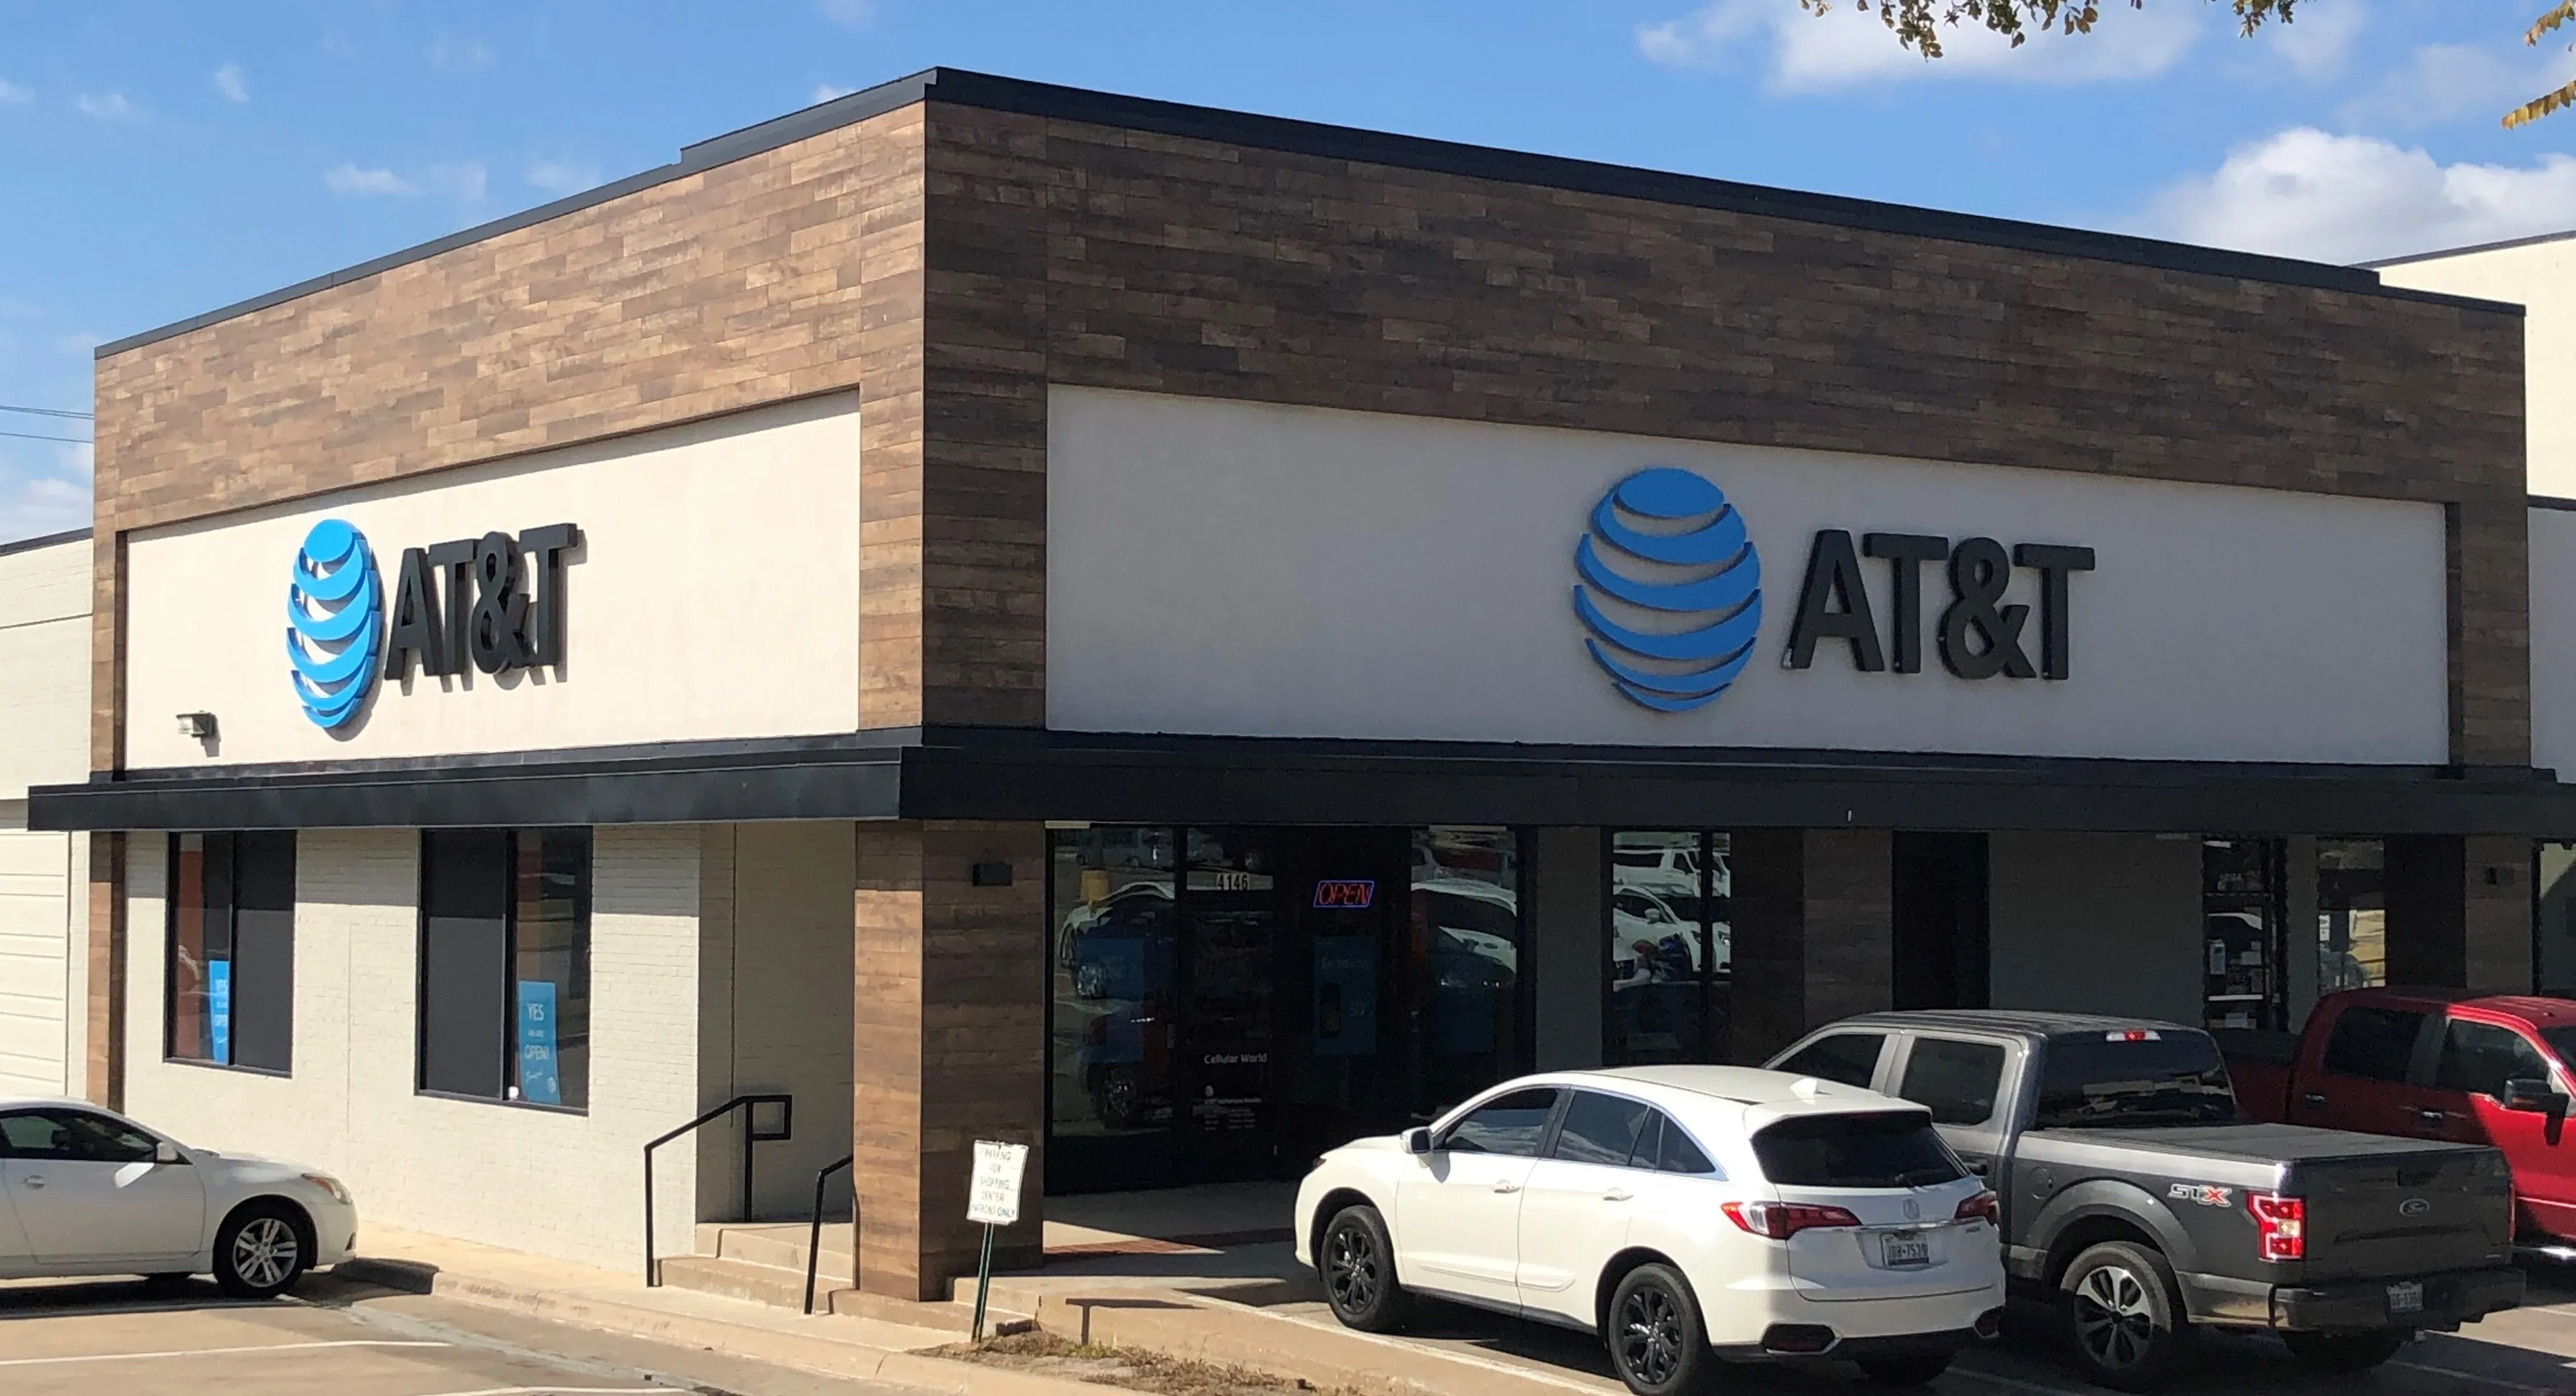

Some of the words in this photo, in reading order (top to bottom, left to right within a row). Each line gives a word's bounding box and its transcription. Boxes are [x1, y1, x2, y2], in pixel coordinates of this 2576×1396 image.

[384, 523, 578, 680] AT&T
[1782, 529, 2096, 680] AT&T
[1217, 872, 1249, 891] 4146
[1318, 882, 1369, 905] OPEN
[526, 1002, 545, 1022] YES
[1204, 1053, 1239, 1064] Cellular
[1240, 1052, 1267, 1063] World
[2166, 1183, 2233, 1208] STX
[997, 1206, 1016, 1218] ONLY
